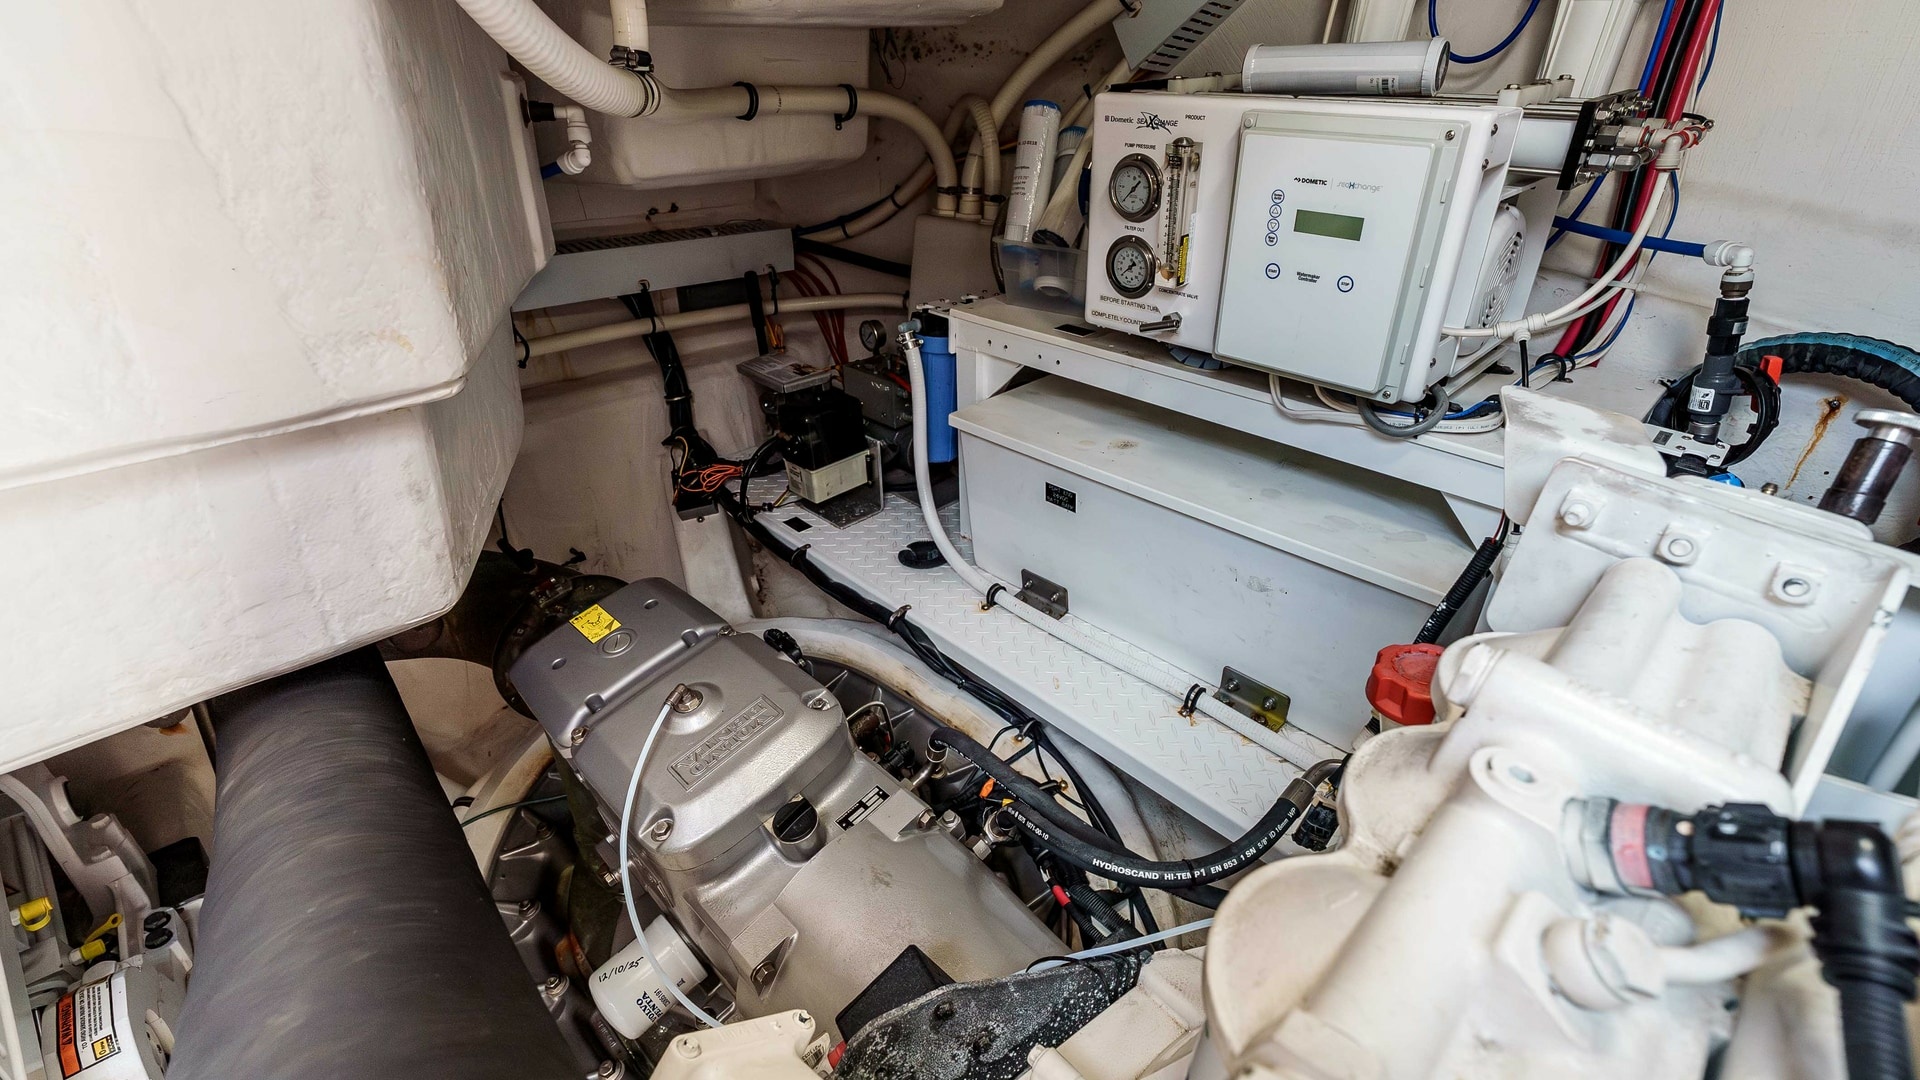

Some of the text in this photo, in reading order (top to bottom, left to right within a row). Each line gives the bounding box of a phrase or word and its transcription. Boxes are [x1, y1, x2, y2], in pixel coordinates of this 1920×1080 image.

[1296, 271, 1320, 279] Watermaker
[1100, 295, 1120, 304] BEFORE
[1120, 298, 1146, 310] STARTING
[1186, 291, 1198, 300] VALVE
[1091, 310, 1123, 321] COMPLETELY
[1092, 858, 1159, 880] HYDROSCAND
[1210, 866, 1222, 875] EN
[1223, 859, 1238, 870] 853
[1245, 847, 1256, 857] SN
[1269, 831, 1276, 839] ID
[1275, 818, 1289, 832] 16mm
[1288, 807, 1296, 818] WP
[598, 956, 644, 982] 12/10/25
[636, 998, 657, 1022] VOLVO
[642, 991, 663, 1018] PENTA
